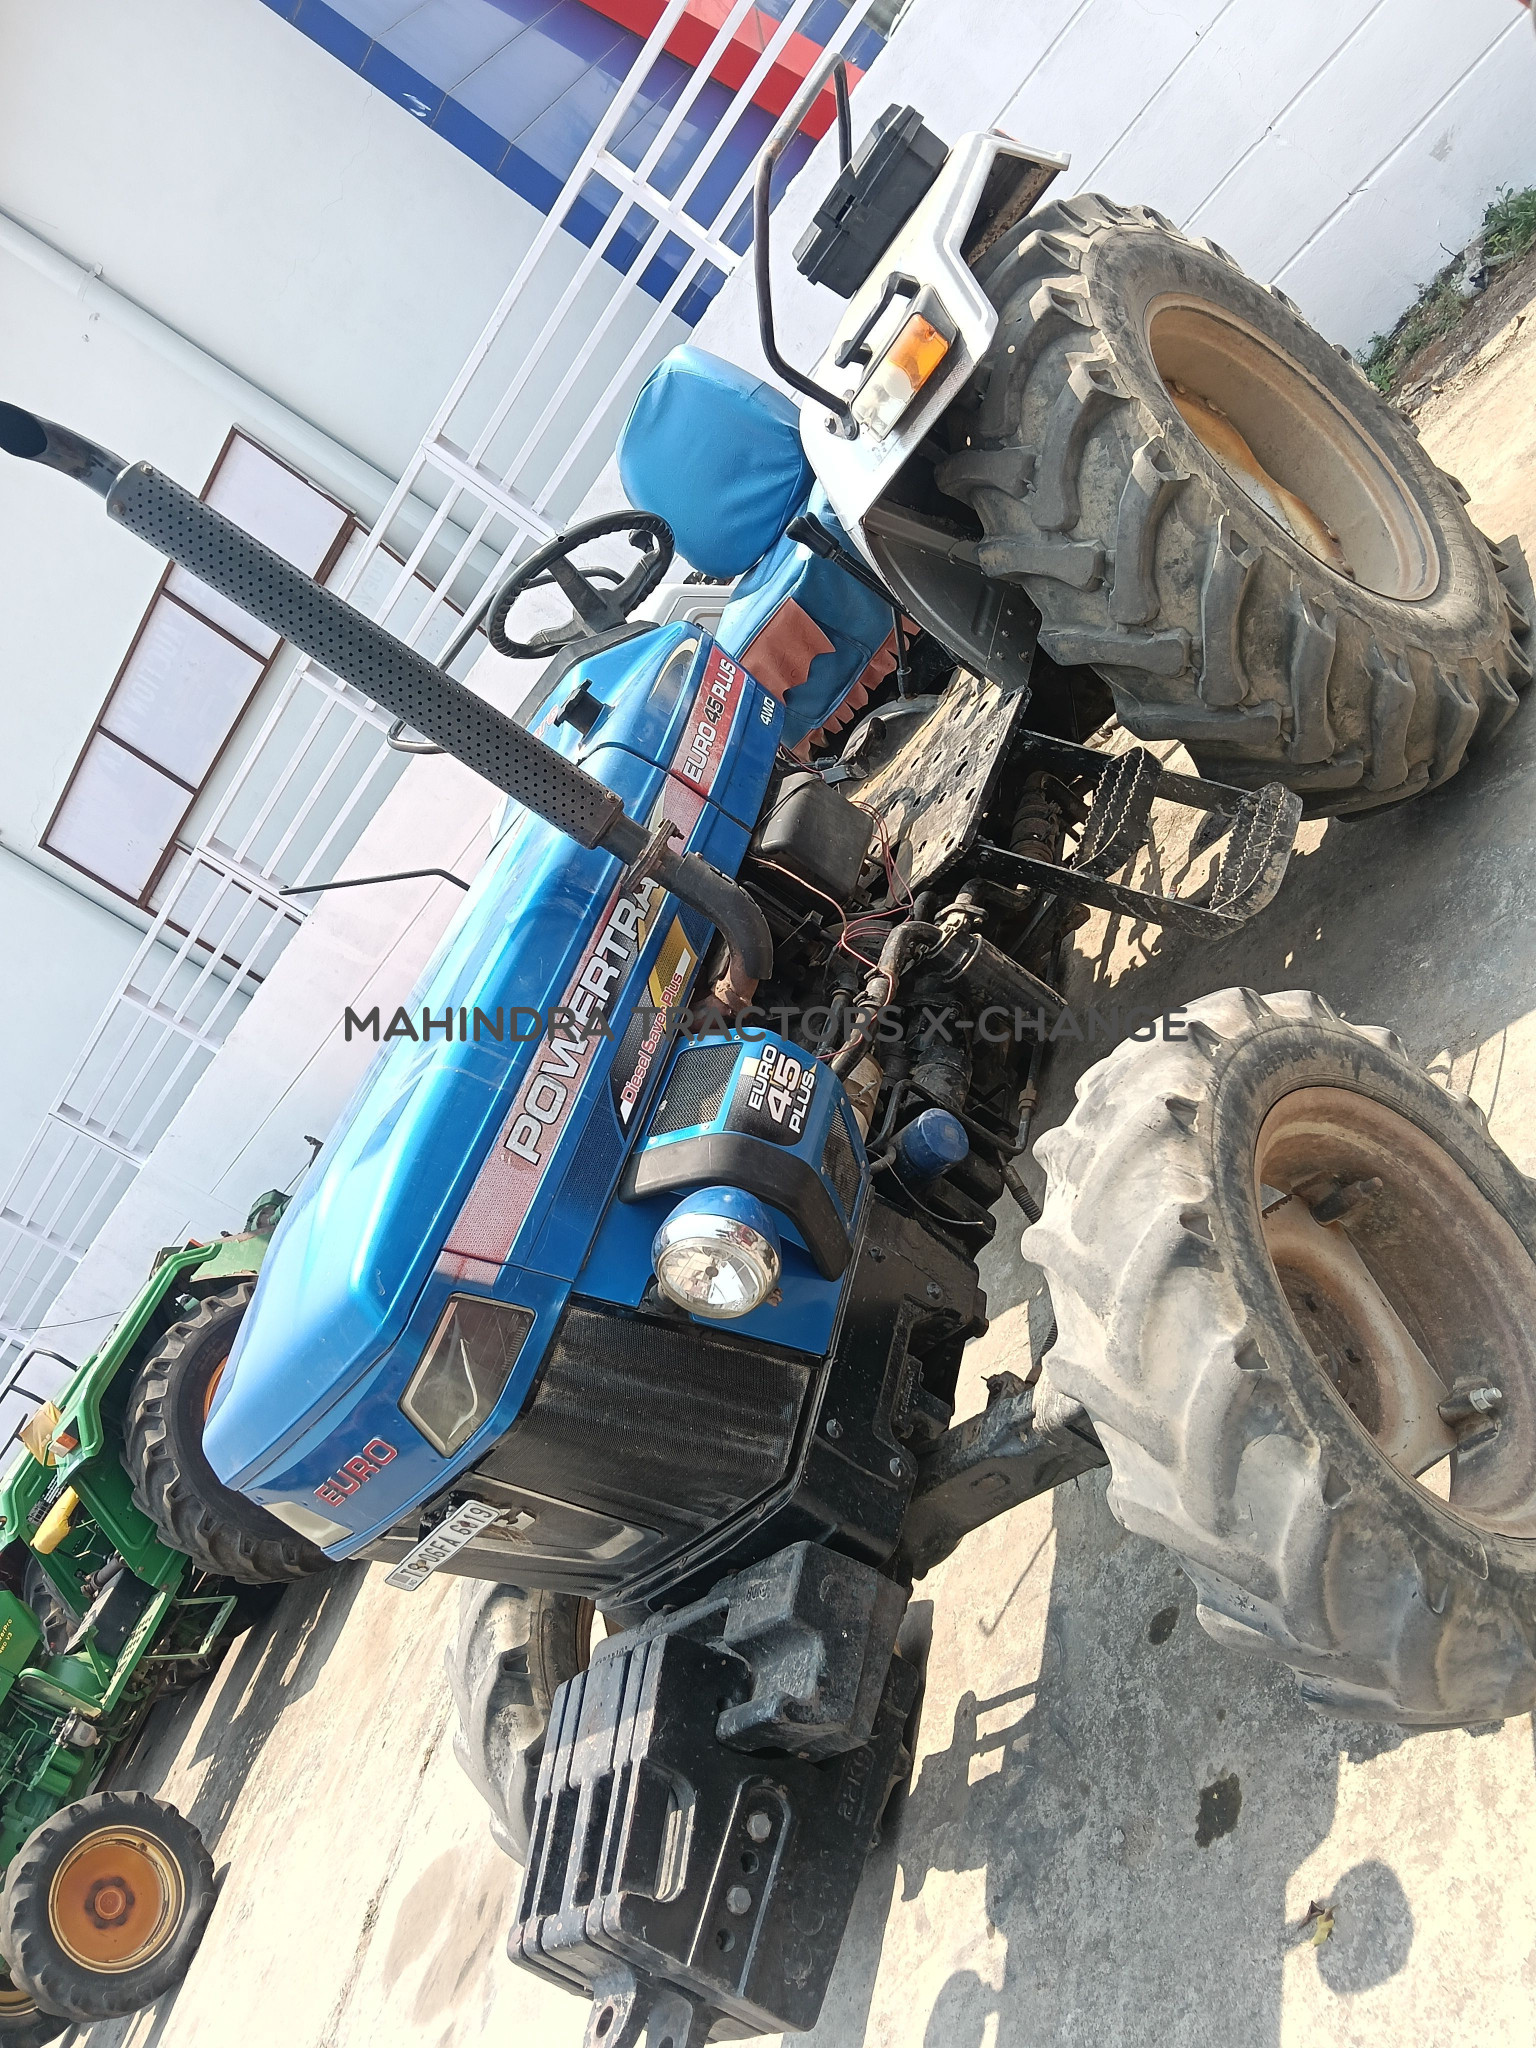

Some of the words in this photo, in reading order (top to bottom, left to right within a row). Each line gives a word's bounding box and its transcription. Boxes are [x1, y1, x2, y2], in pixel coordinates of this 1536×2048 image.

[704, 695, 725, 725] 45
[711, 658, 736, 702] PLUS
[760, 696, 775, 726] 4WD
[682, 721, 717, 784] EURO
[503, 876, 660, 1166] POWERTRA
[620, 1051, 651, 1104] Diesel
[641, 1004, 668, 1055] Saver
[660, 972, 683, 1007] Plus
[748, 1044, 778, 1111] EURO
[766, 1053, 801, 1124] 45
[788, 1069, 816, 1134] PLUS
[313, 1437, 398, 1507] EURO
